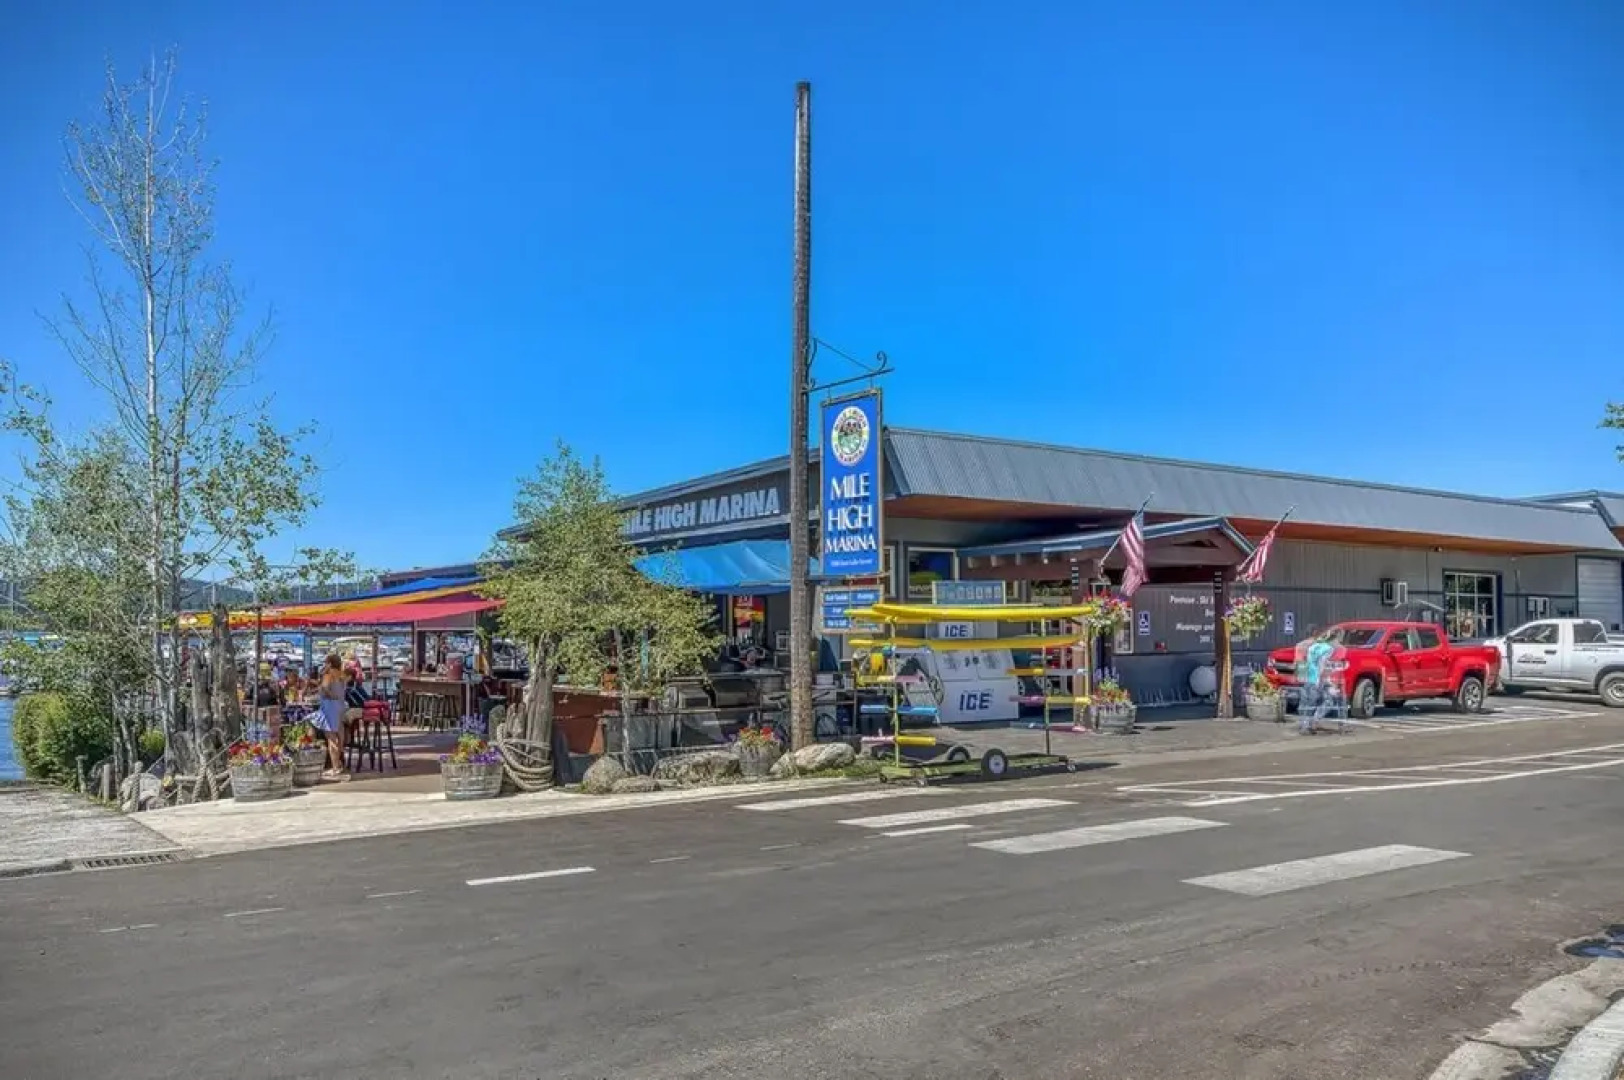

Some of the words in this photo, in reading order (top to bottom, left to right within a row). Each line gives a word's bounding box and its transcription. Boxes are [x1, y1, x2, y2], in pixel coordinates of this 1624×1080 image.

[831, 472, 870, 500] MILE
[655, 501, 696, 531] HIGH
[699, 487, 780, 525] MARINA
[827, 504, 873, 531] HIGH
[825, 533, 877, 554] MARINA
[945, 624, 969, 637] ICE
[959, 692, 992, 711] ICE
